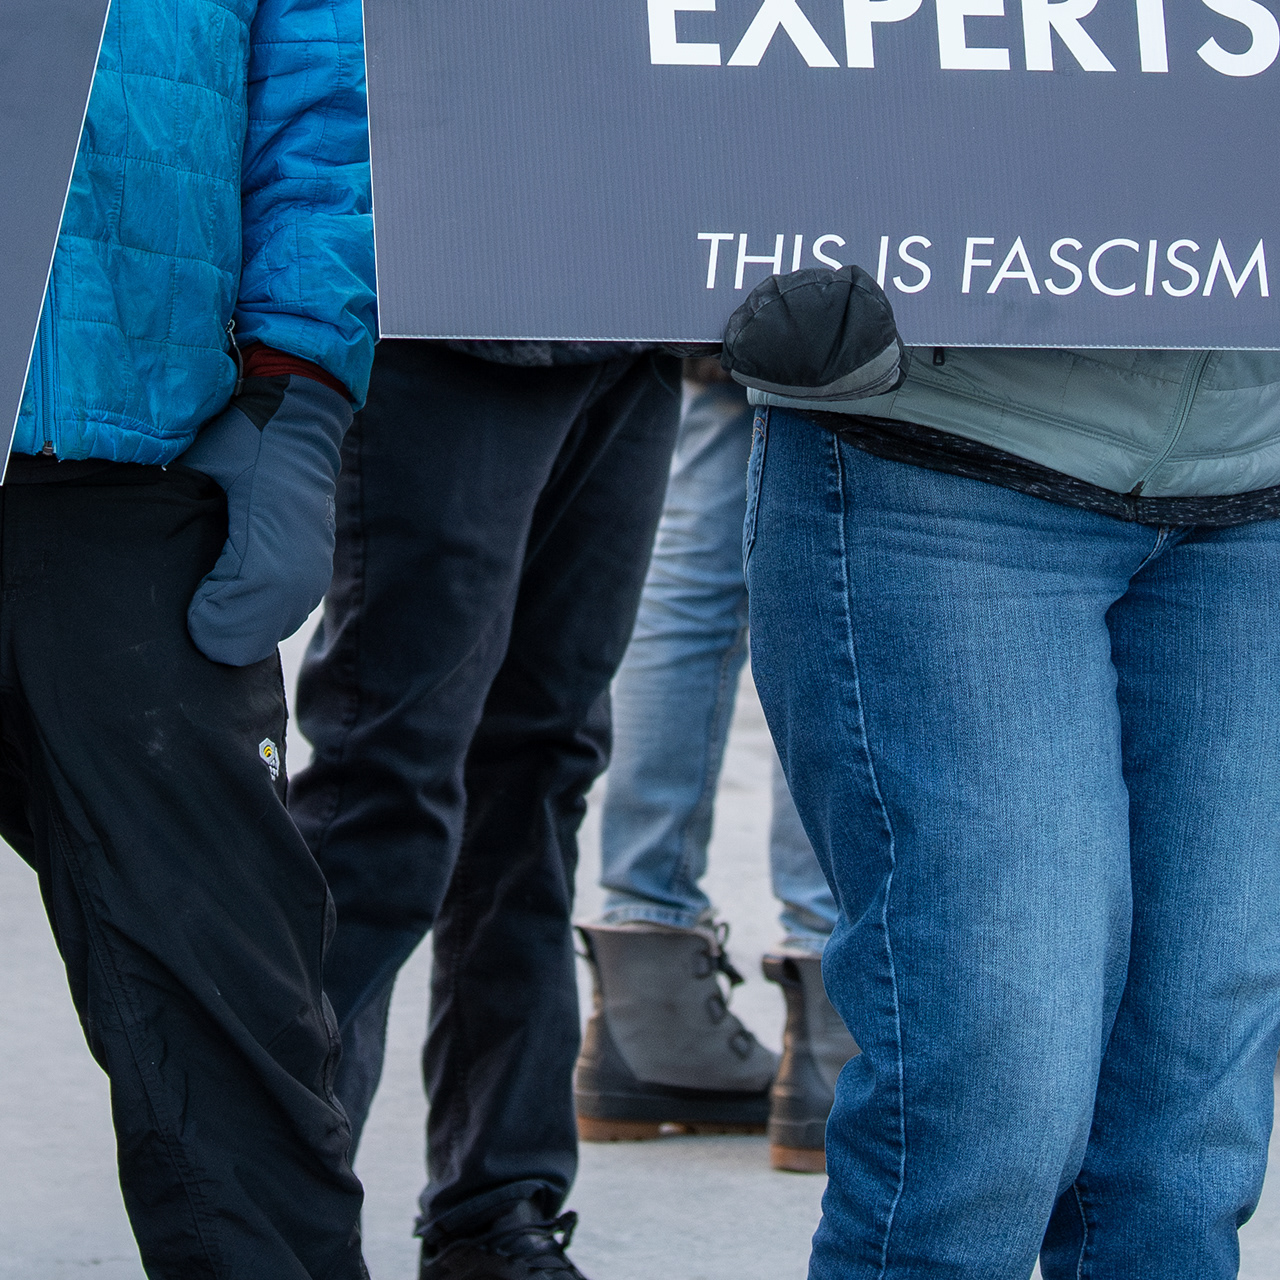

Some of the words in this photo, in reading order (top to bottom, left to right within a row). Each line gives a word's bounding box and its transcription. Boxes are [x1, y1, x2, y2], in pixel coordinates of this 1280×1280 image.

[697, 232, 846, 290] THIS
[876, 235, 932, 294] IS
[962, 235, 1270, 299] FASCISM
